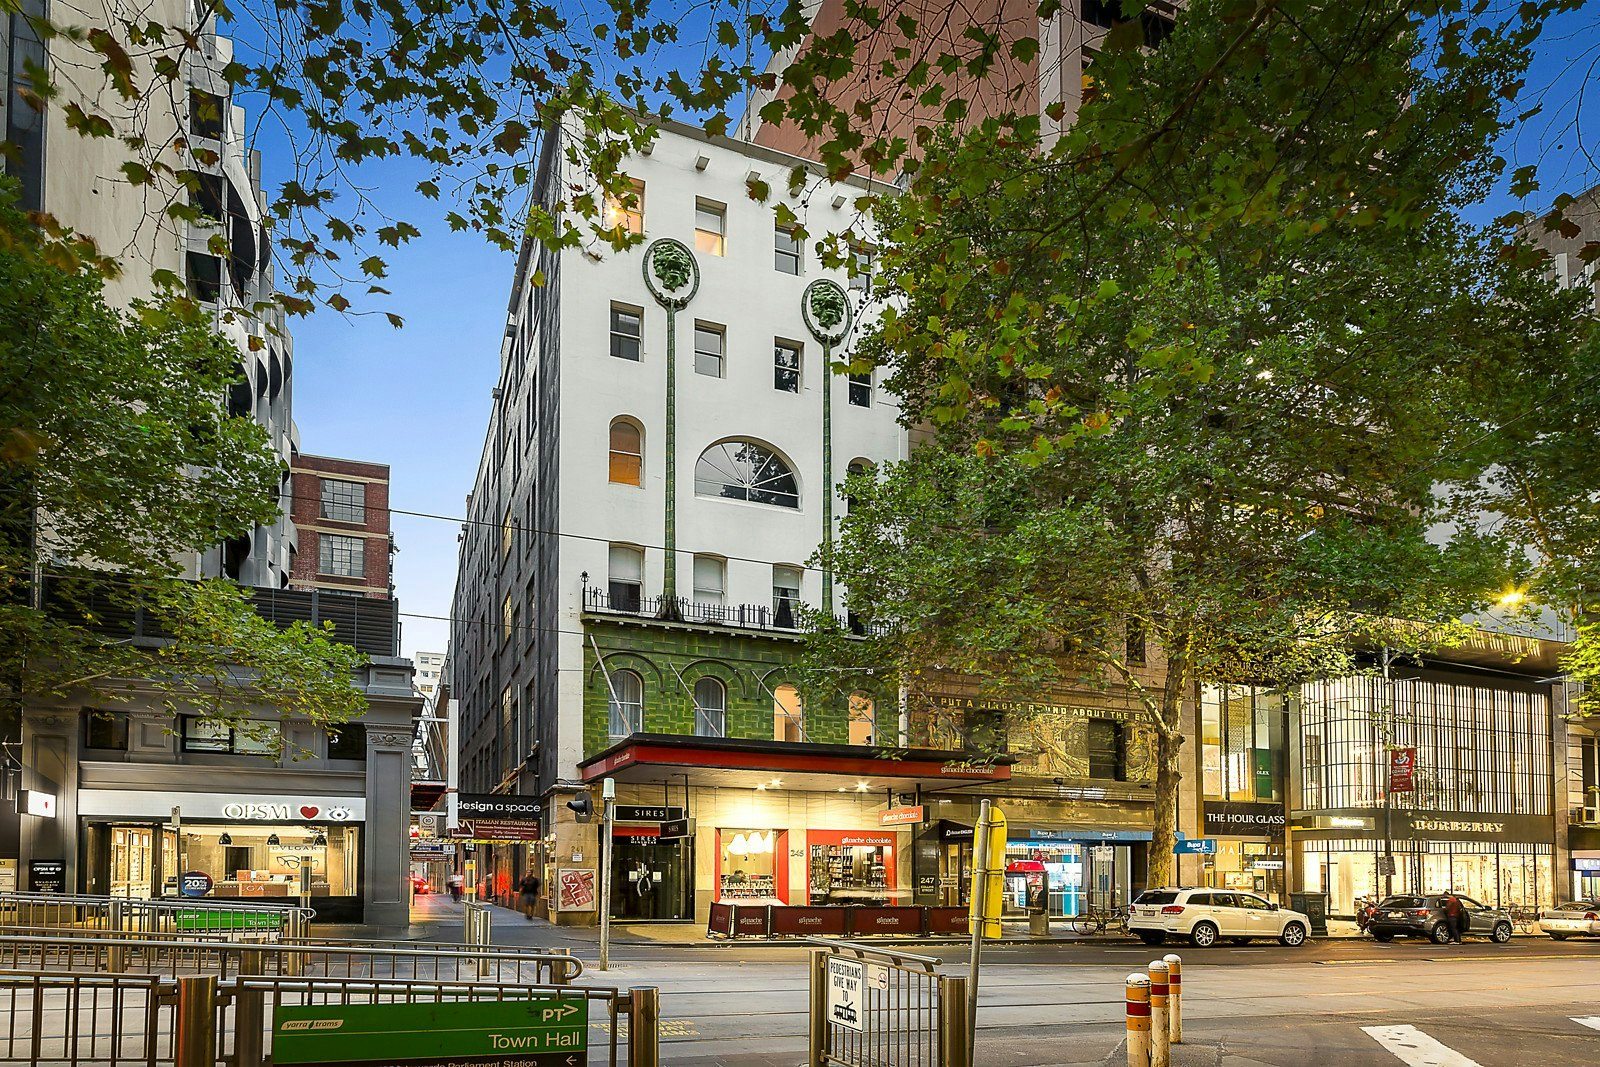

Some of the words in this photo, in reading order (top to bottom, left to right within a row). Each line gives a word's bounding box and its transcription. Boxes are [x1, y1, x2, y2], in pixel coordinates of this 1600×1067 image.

[941, 697, 962, 707] PUT
[966, 699, 974, 708] A
[1072, 708, 1106, 718] ABOUT
[1111, 711, 1129, 720] THE
[965, 767, 994, 775] chocolate
[224, 804, 289, 820] OPSM
[457, 801, 494, 812] design
[495, 803, 504, 811] a
[505, 804, 541, 813] space
[634, 809, 665, 817] SIRES
[1207, 813, 1225, 822] THE
[1227, 814, 1255, 824] HOUR
[1255, 815, 1286, 825] GLASS
[1414, 819, 1504, 833] BURBERRY
[790, 849, 805, 858] 245
[562, 874, 588, 905] SALE
[830, 961, 862, 980] PEDESTRIANS
[833, 975, 845, 989] GIVE
[845, 978, 858, 992] WAY
[842, 990, 849, 1003] TO
[488, 1033, 538, 1049] Town
[545, 1031, 581, 1047] Hall
[503, 1059, 537, 1067] Station
